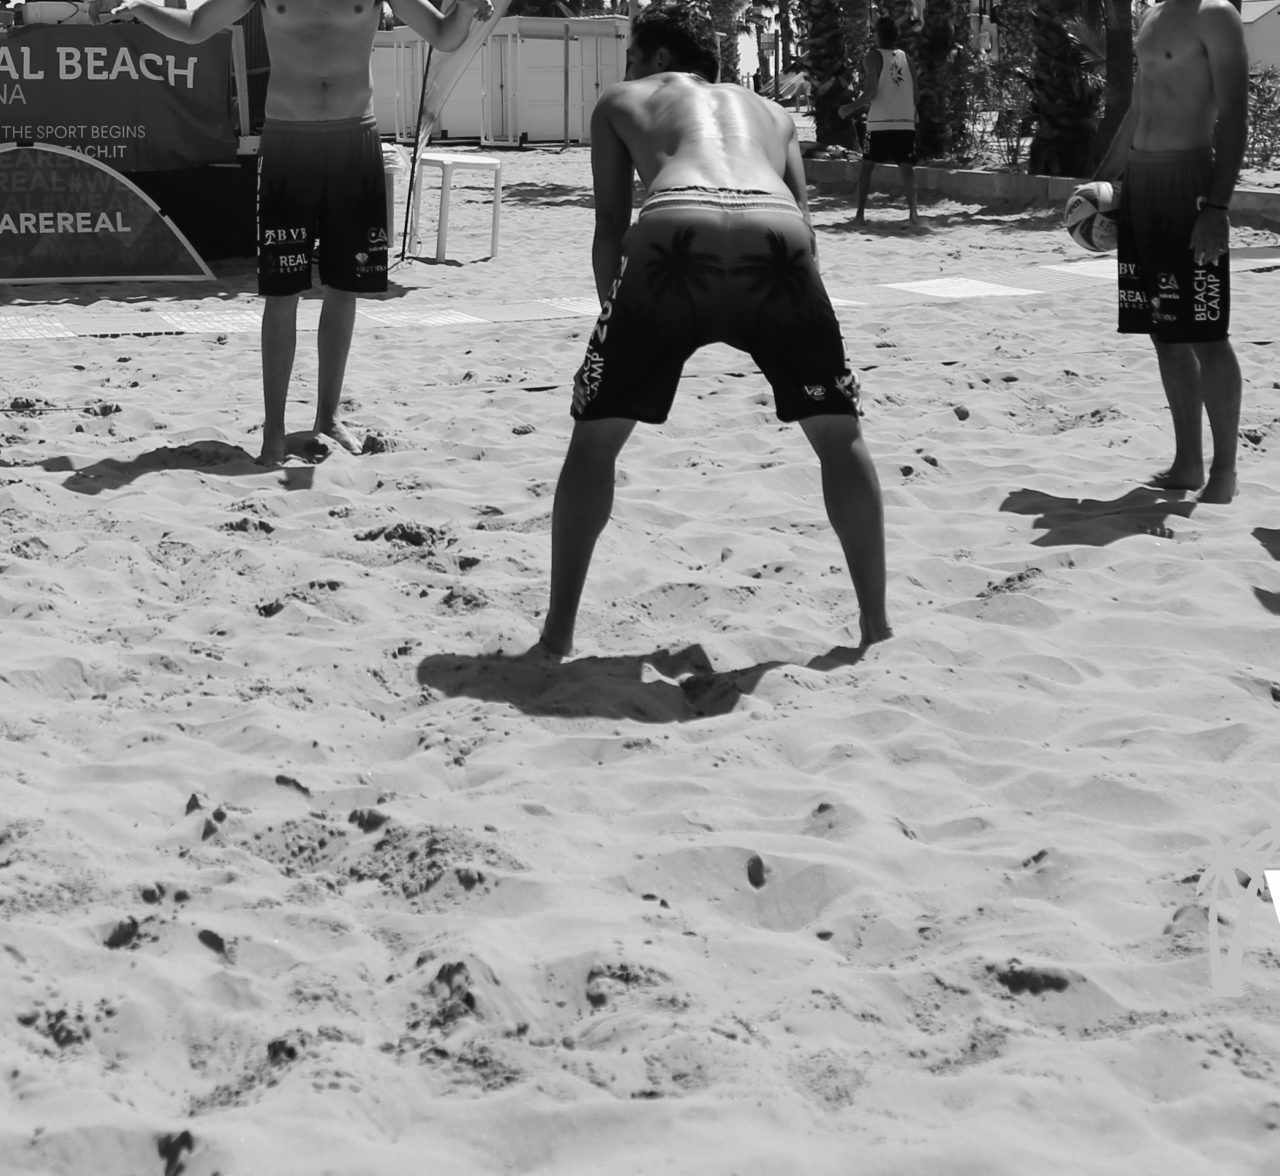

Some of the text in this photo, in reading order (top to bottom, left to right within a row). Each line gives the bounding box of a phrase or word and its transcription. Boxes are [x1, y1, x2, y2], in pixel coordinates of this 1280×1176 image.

[56, 46, 198, 89] BEACH
[1, 125, 33, 139] THE
[36, 125, 88, 139] SPORT
[91, 125, 147, 139] BEGINS
[279, 253, 308, 267] REAL
[1194, 270, 1207, 321] BEACH
[1207, 274, 1220, 321] CAMP
